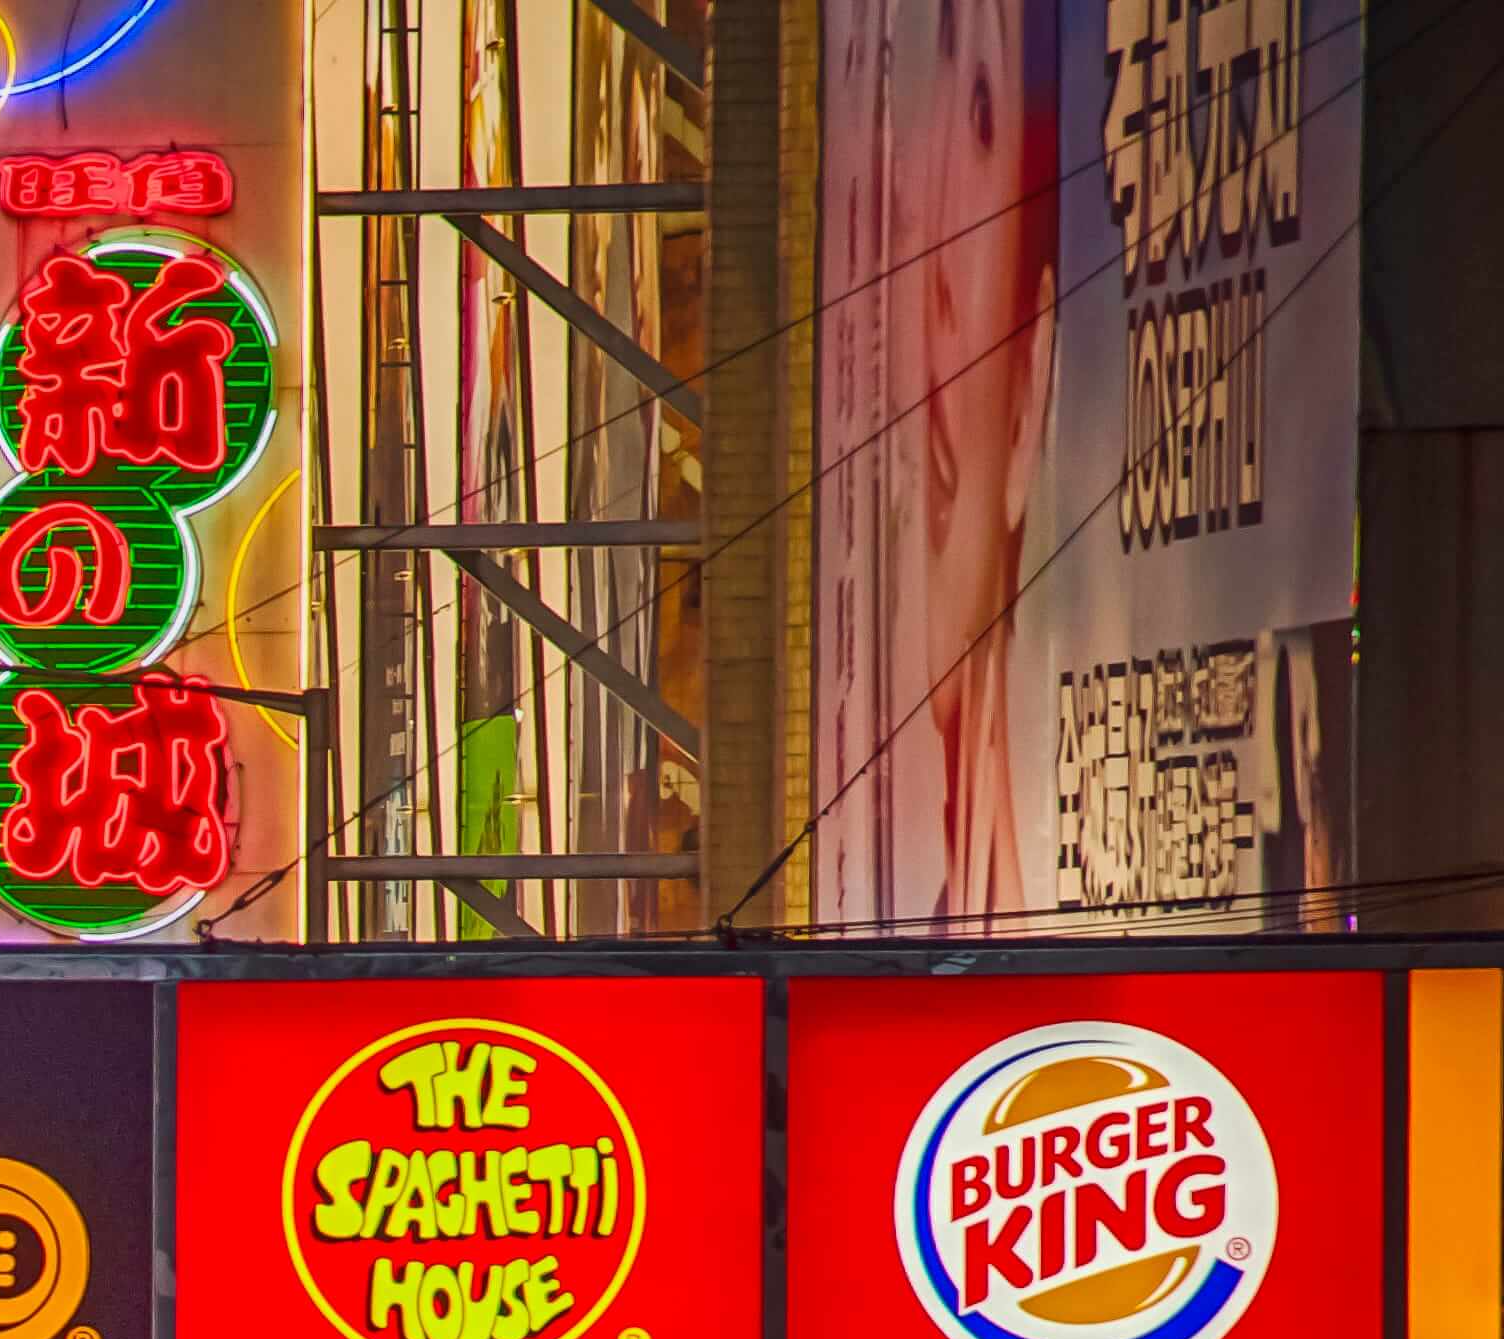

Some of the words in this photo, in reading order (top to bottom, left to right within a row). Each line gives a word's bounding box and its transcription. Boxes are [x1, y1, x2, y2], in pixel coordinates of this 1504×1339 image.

[380, 1041, 536, 1130] THE
[949, 1095, 1215, 1222] BURGER
[959, 1154, 1228, 1317] KING
